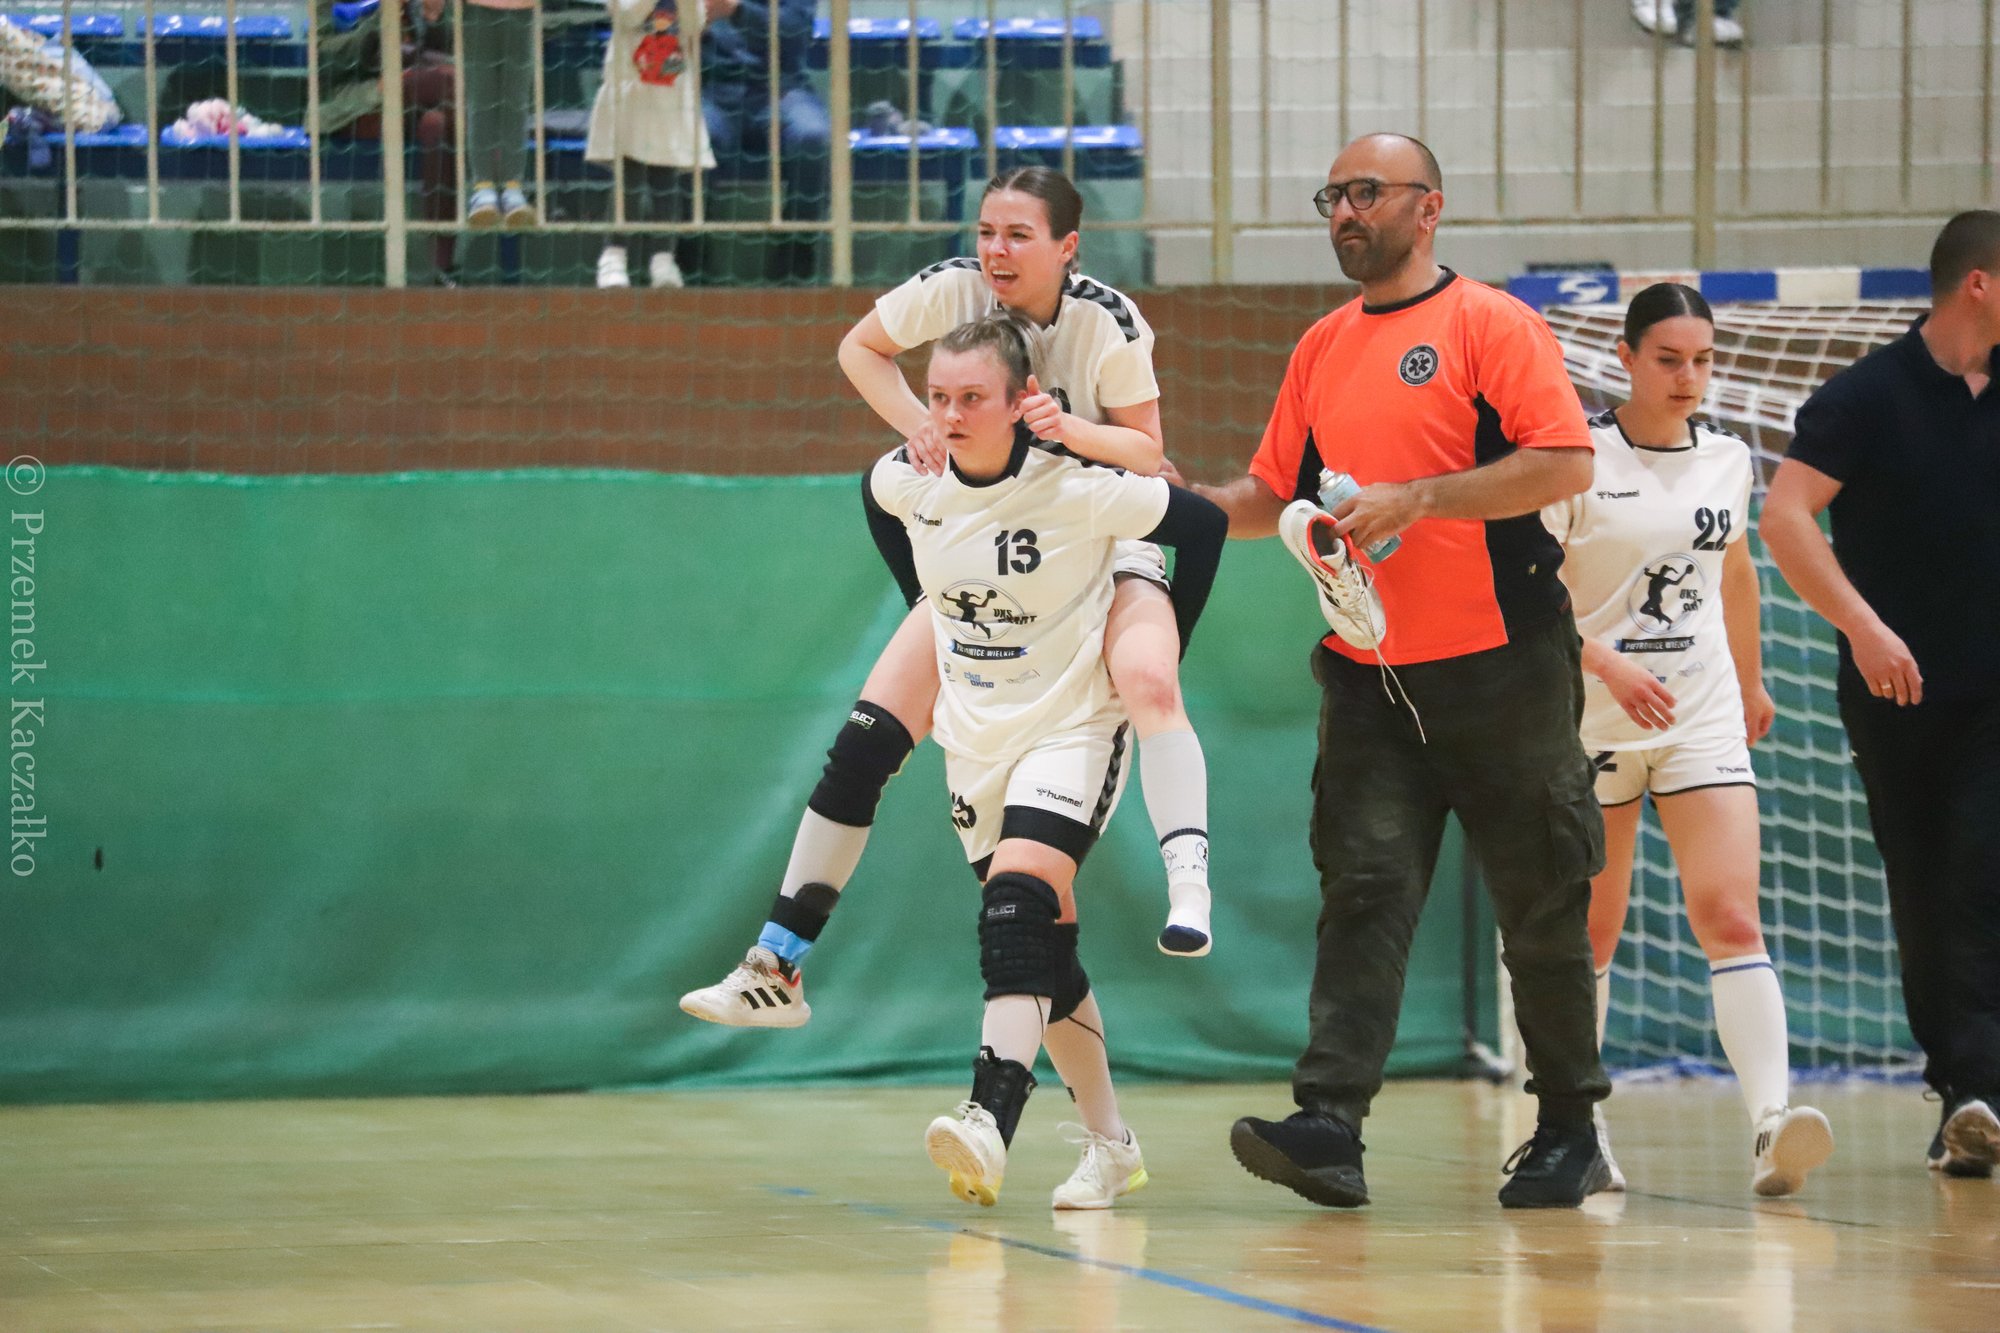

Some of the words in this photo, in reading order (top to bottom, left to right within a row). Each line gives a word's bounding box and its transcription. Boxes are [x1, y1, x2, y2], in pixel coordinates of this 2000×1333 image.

[1692, 507, 1731, 551] 22
[994, 528, 1041, 576] 13
[850, 710, 876, 726] SELECT
[1047, 789, 1084, 808] hummel
[987, 904, 1016, 917] SELECT
